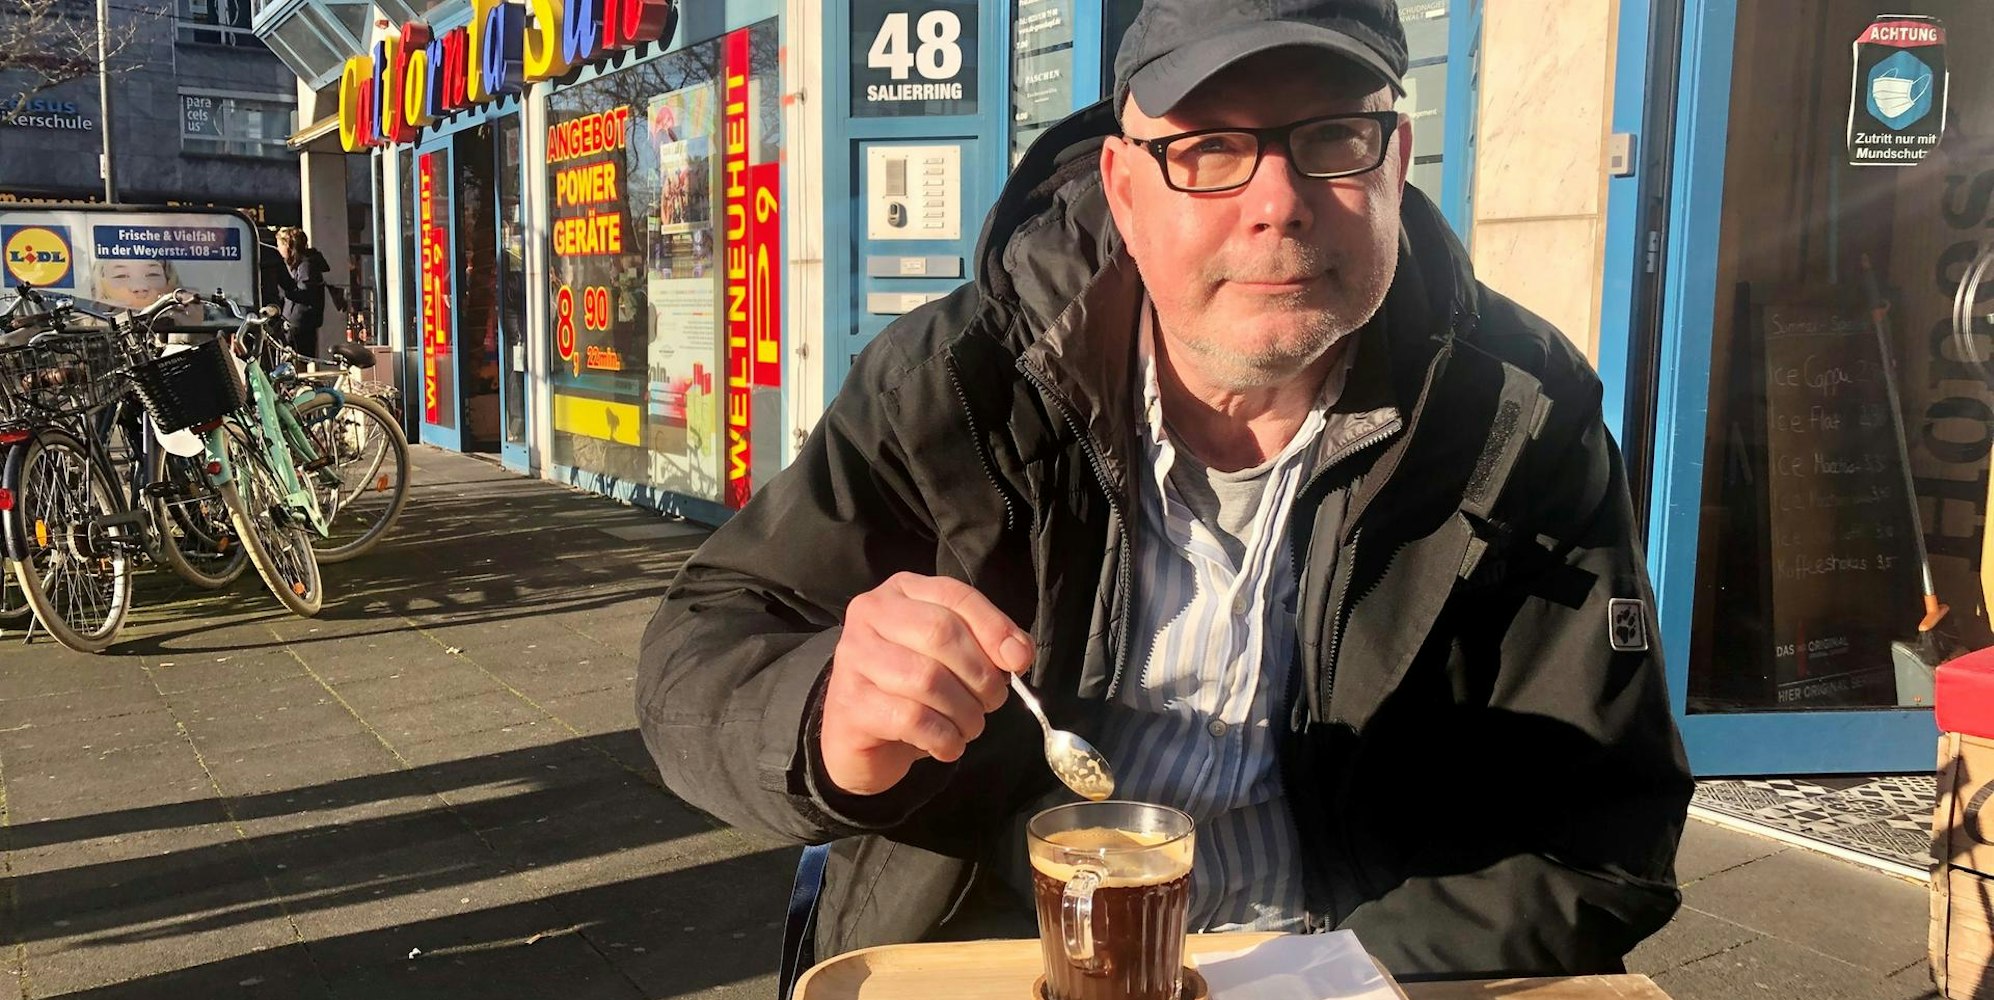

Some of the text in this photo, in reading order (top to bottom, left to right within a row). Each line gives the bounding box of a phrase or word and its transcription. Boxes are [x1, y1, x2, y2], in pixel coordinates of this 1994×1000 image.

[1870, 27, 1937, 42] ACHTUNG
[867, 10, 962, 80] 48
[867, 83, 962, 102] SALIERRING
[186, 96, 212, 110] para
[187, 109, 209, 121] cels
[546, 105, 629, 163] ANGEBOT
[1855, 132, 1937, 145] Zutritt nur mit
[556, 160, 618, 208] POWER
[118, 229, 216, 242] Frische & Vielfalt
[553, 208, 621, 256] GERÄTE
[97, 244, 109, 256] in
[111, 244, 131, 256] der
[133, 244, 188, 259] Weyerstr.
[189, 246, 210, 257] 108
[220, 246, 238, 257] 112
[726, 66, 747, 480] WELTNEUHEIT
[421, 170, 436, 409] WELTNEUHEIT
[1776, 644, 1795, 657] DAS
[1777, 686, 1803, 703] HIER
